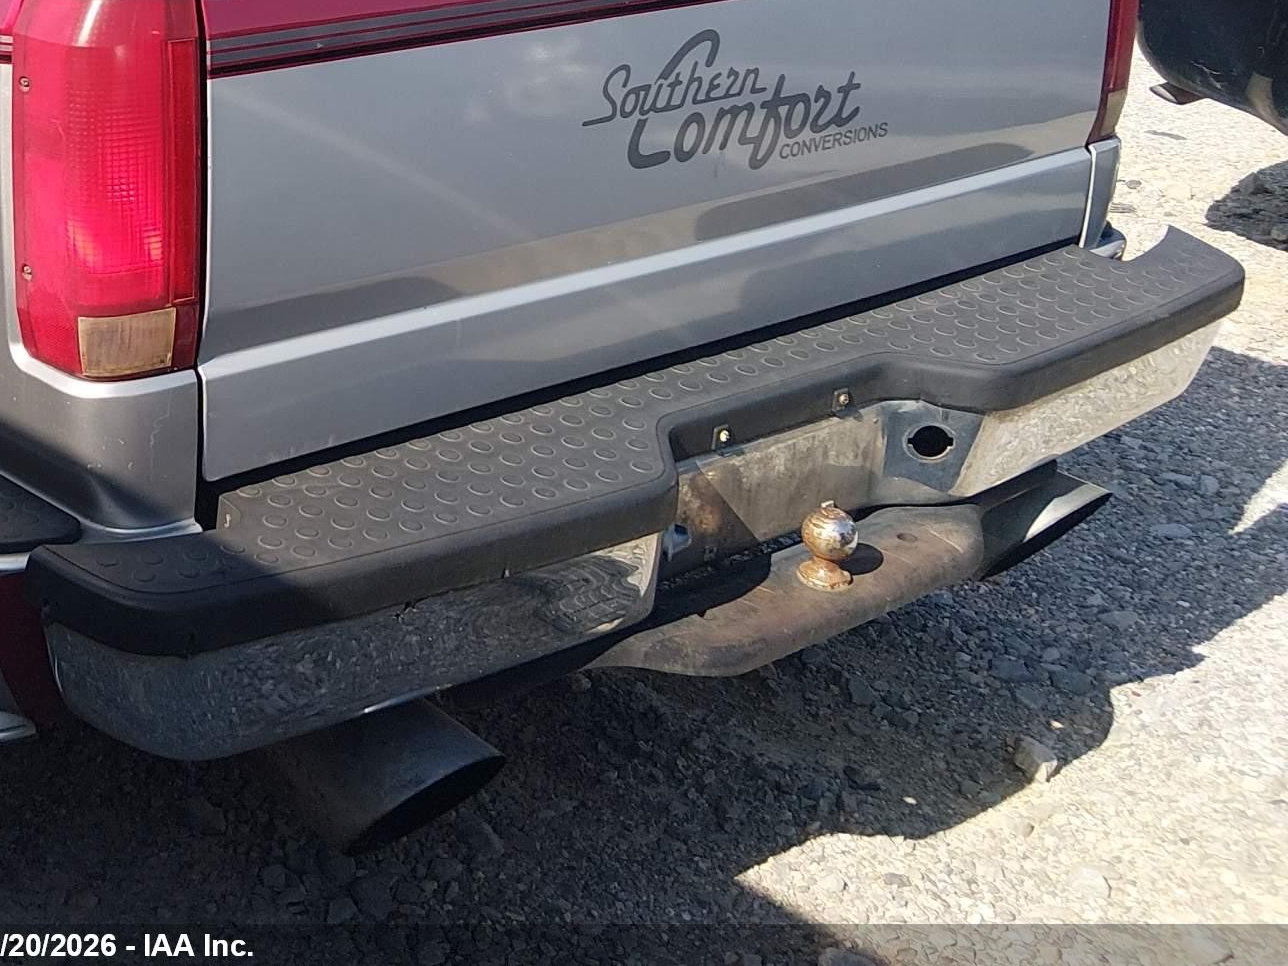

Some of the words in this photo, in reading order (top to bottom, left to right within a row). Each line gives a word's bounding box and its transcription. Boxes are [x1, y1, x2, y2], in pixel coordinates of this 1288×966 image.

[582, 60, 767, 127] Southern
[627, 29, 861, 170] Comfort
[779, 122, 889, 159] CONVERSIONS
